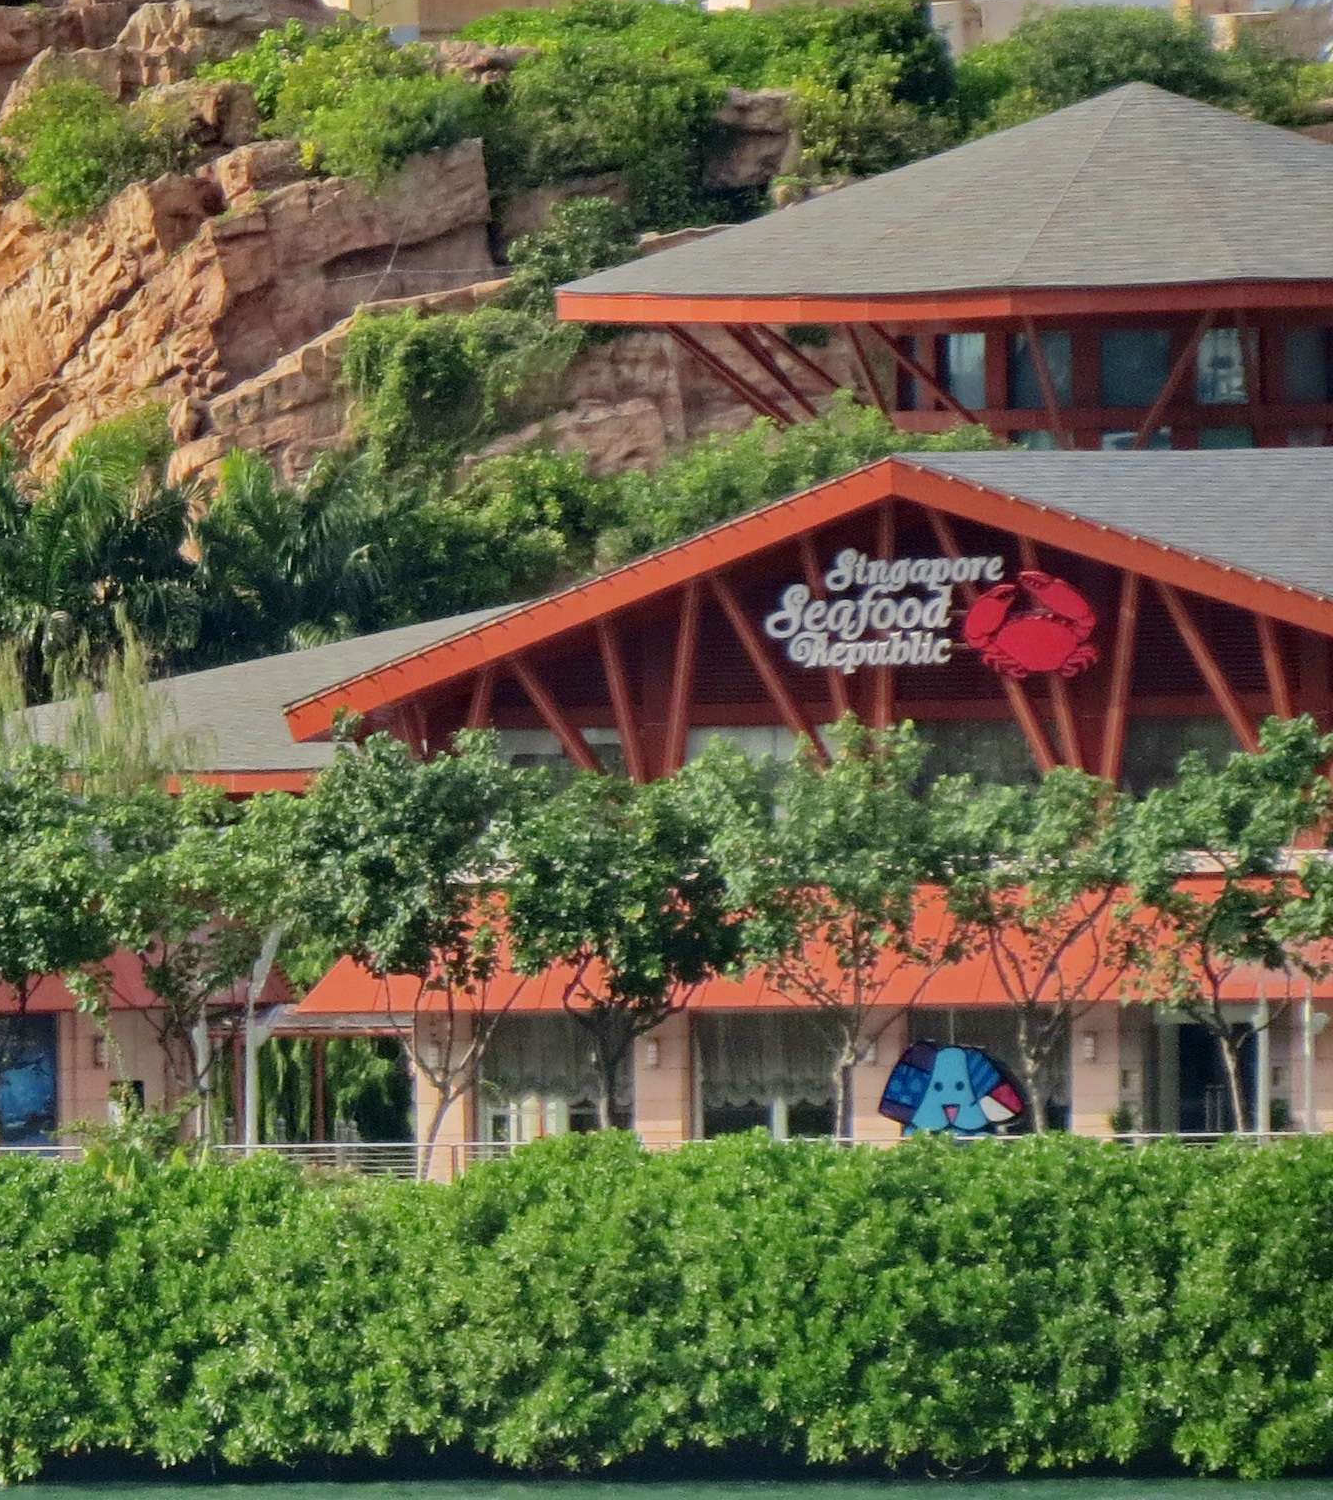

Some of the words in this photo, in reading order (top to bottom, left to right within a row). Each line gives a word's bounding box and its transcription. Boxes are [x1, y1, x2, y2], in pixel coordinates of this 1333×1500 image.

[825, 547, 1006, 592] Singapore
[764, 583, 952, 641] Seafood
[788, 630, 952, 675] Republic
